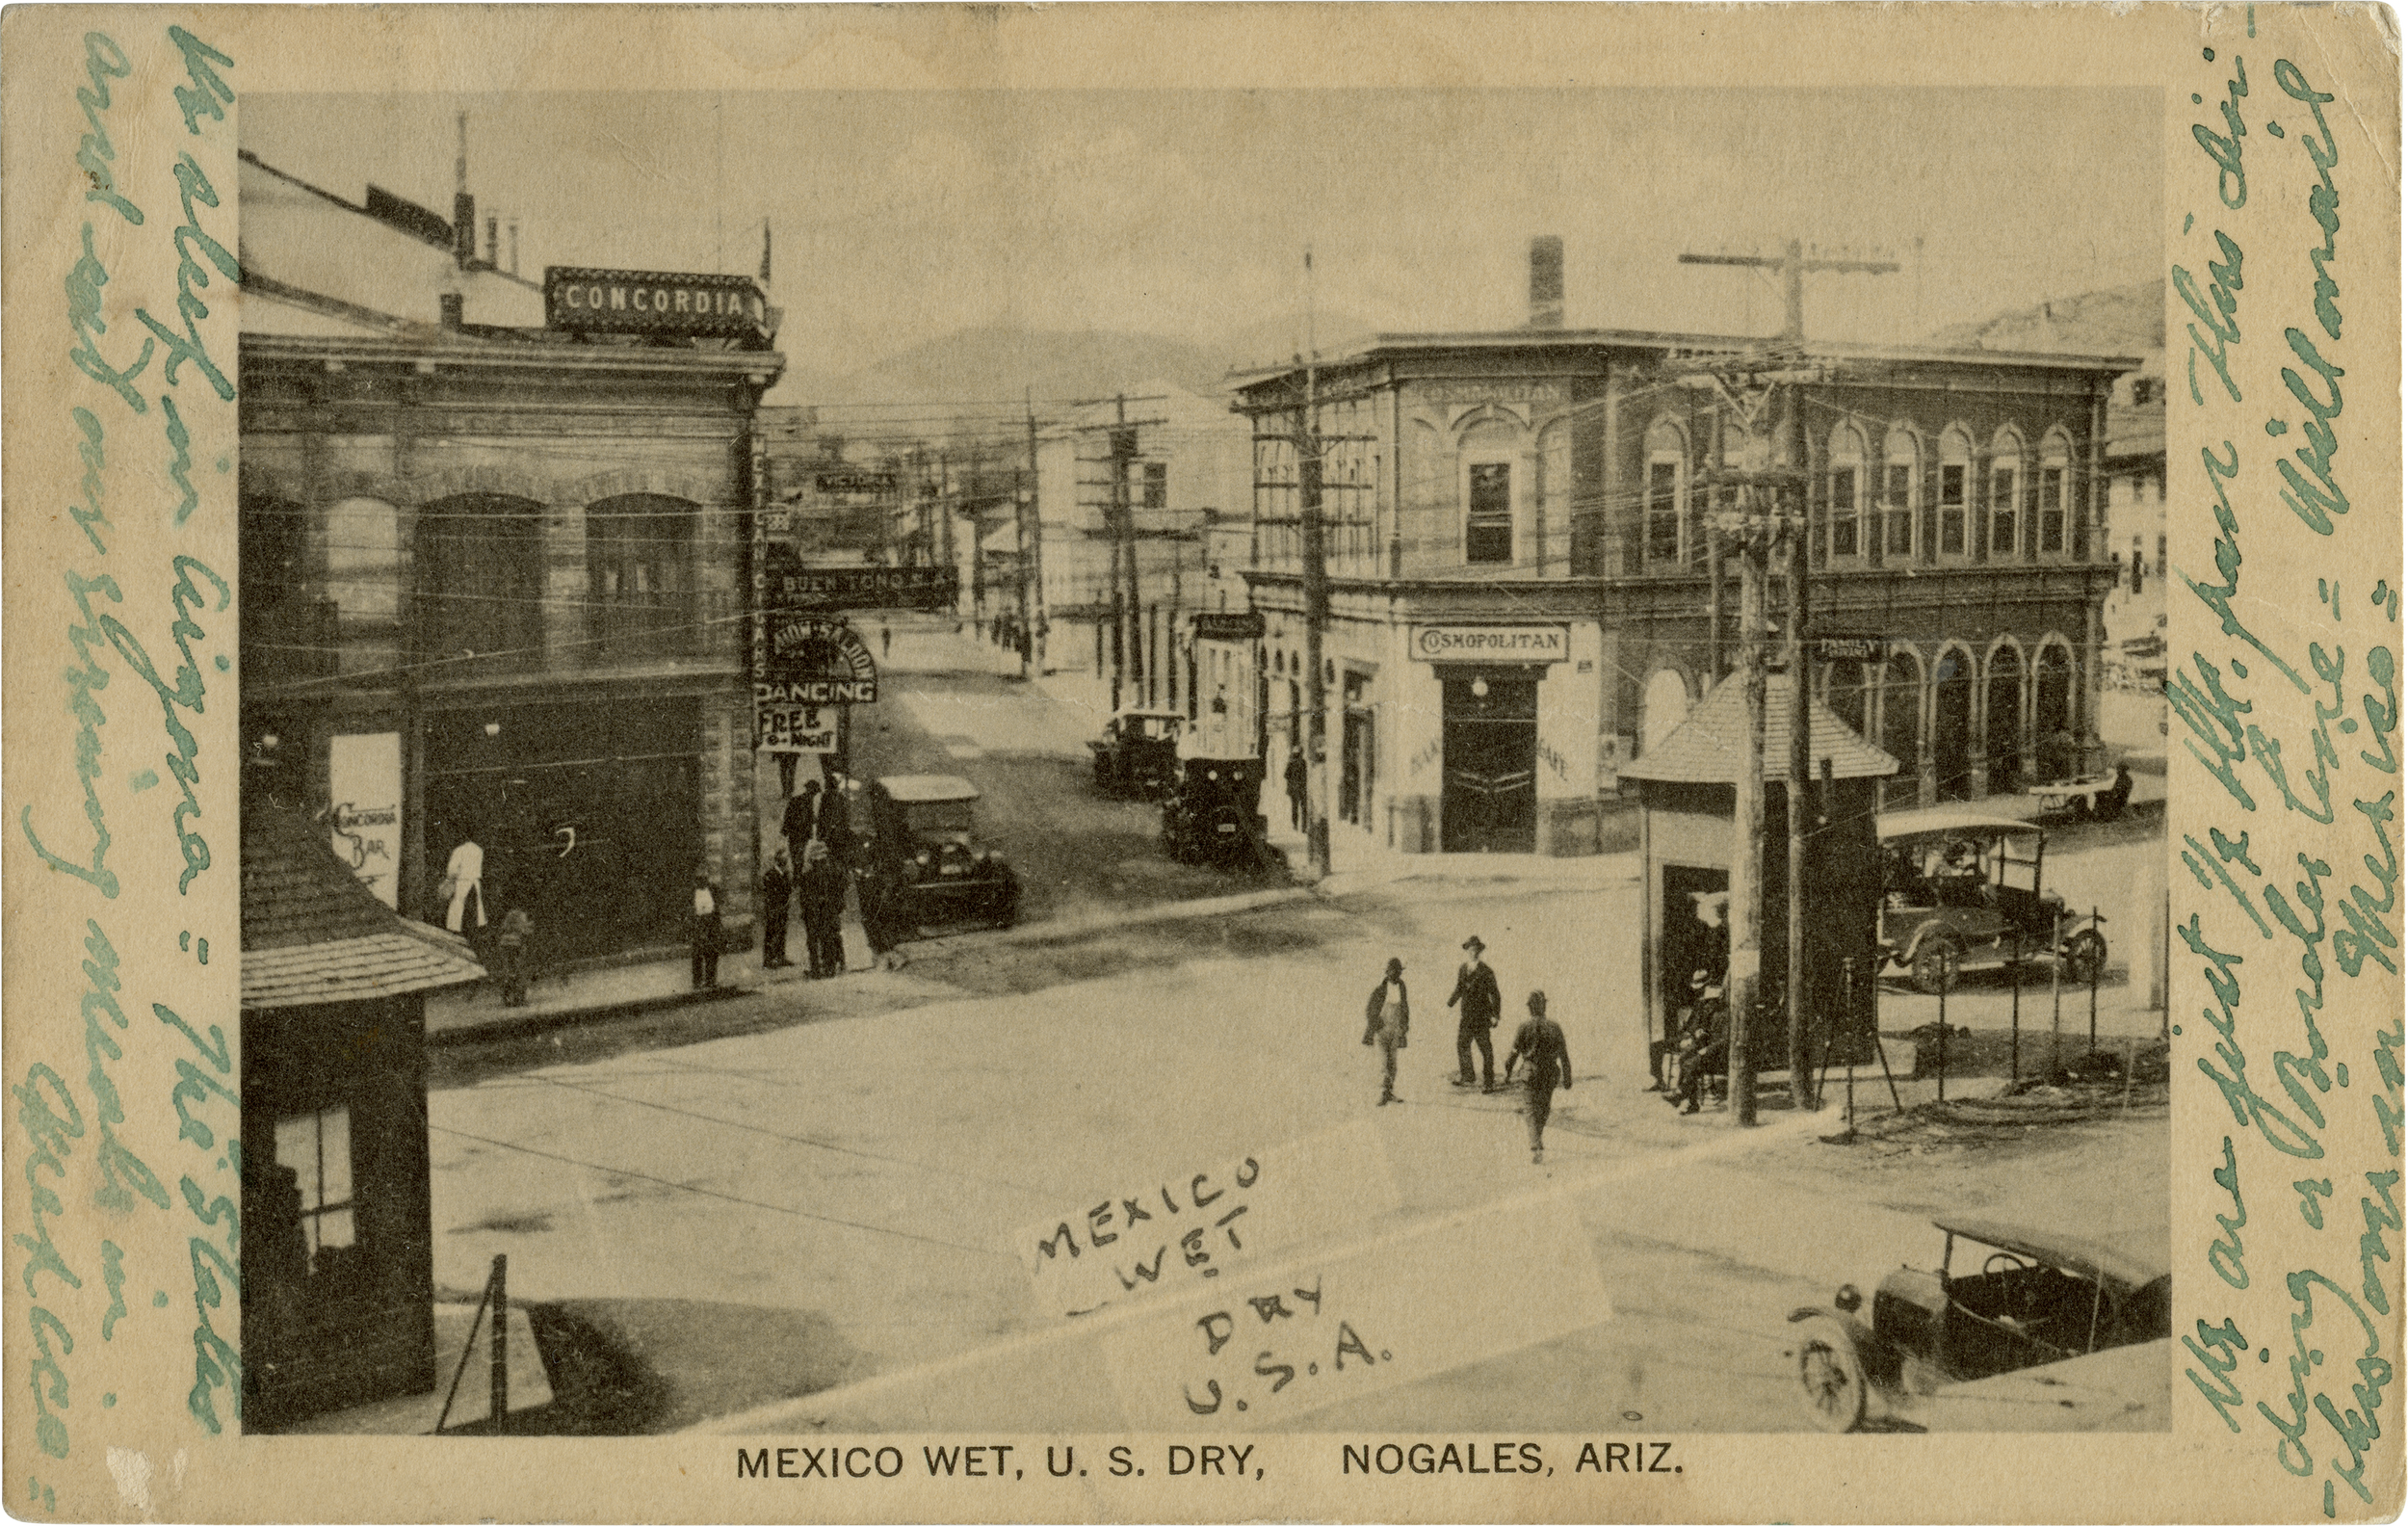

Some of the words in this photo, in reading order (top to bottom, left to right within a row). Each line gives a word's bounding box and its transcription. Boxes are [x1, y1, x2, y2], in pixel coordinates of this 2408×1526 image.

[566, 286, 743, 316] CONCORDIA
[783, 576, 837, 592] BUEN
[848, 573, 903, 591] TONO
[753, 572, 768, 678] CIGARS
[1420, 629, 1559, 654] COSMOPOLITAN
[754, 682, 876, 701] DANCING
[757, 707, 822, 733] FREE
[332, 801, 397, 833] CONCORDIA
[350, 833, 391, 871] BAR
[1034, 1156, 1260, 1277] MEXICO
[1113, 1205, 1249, 1293] WET
[1195, 1274, 1322, 1355] DRY
